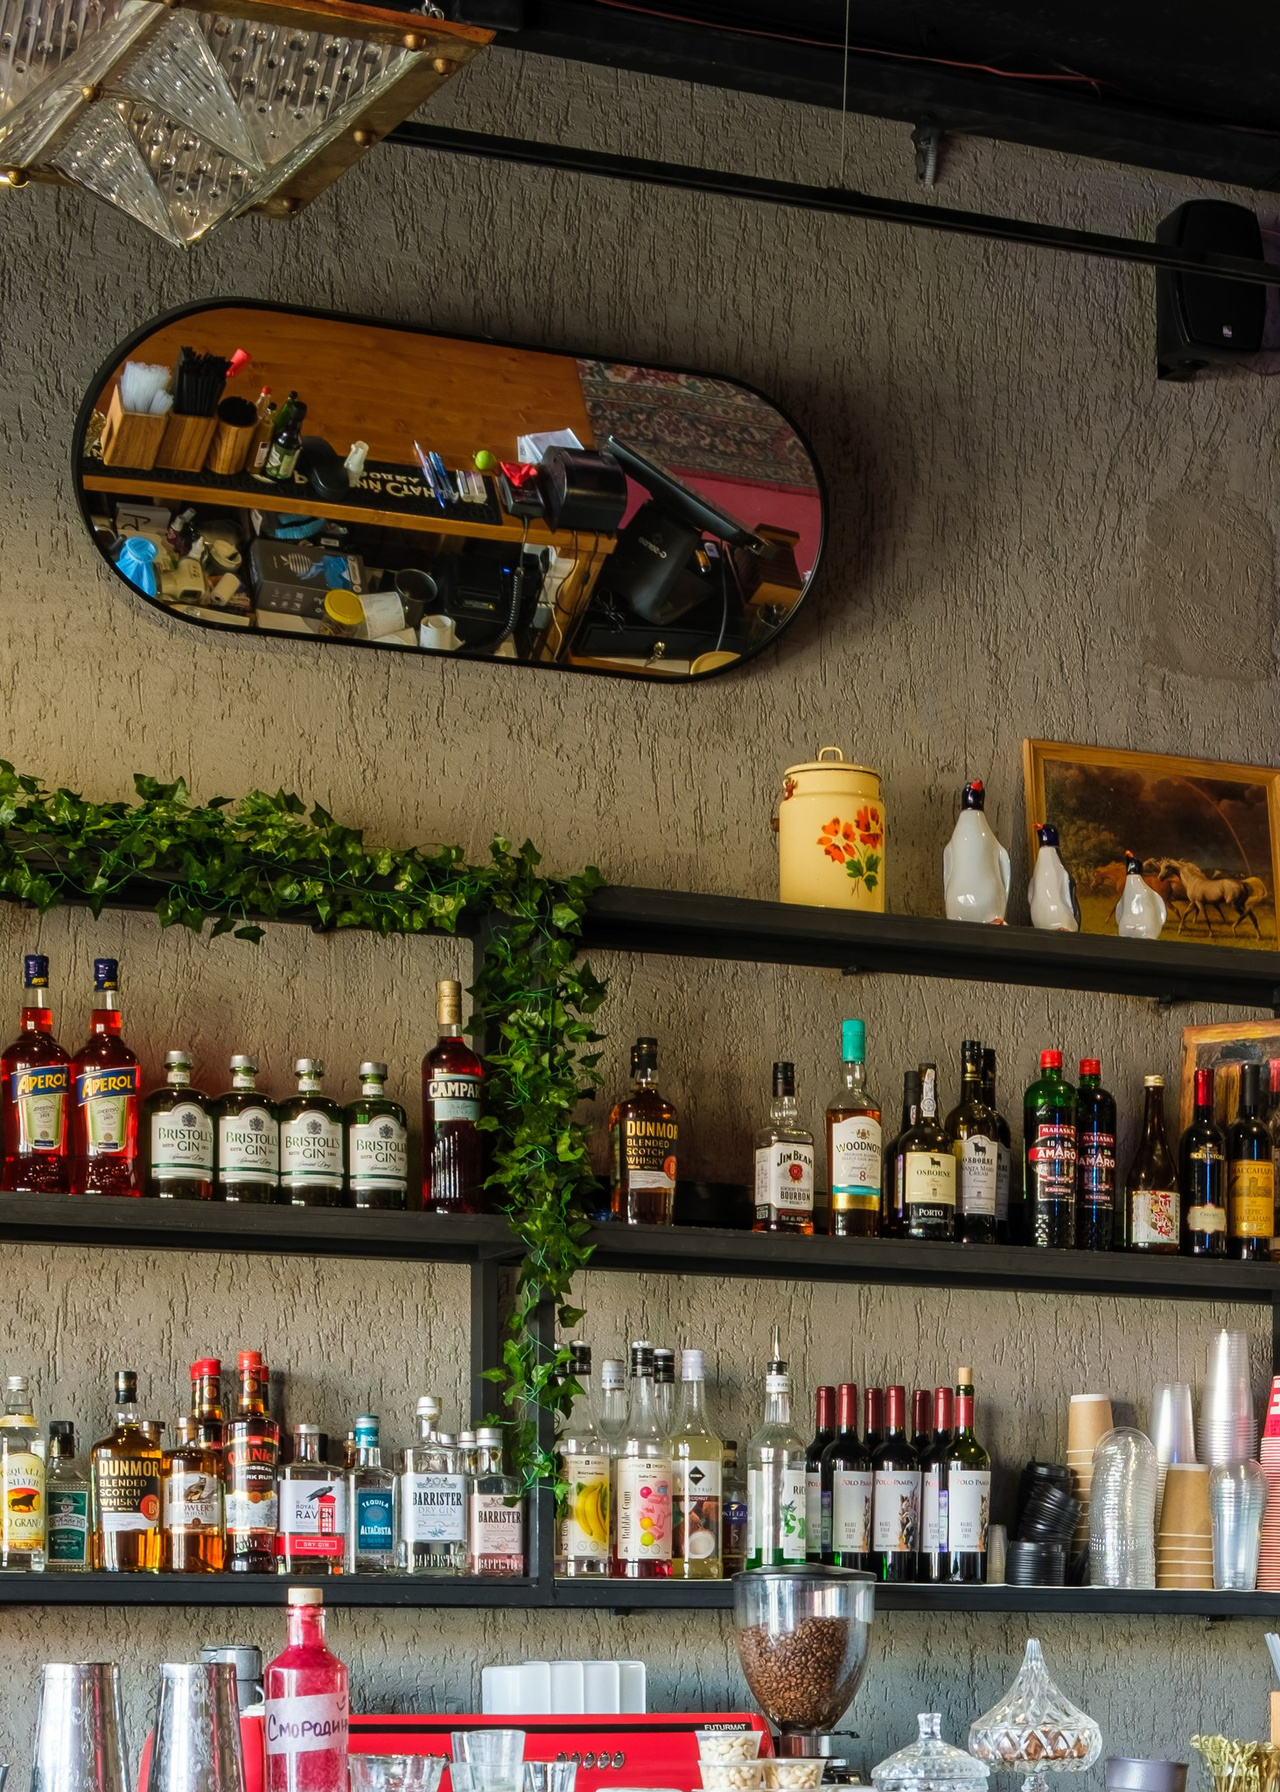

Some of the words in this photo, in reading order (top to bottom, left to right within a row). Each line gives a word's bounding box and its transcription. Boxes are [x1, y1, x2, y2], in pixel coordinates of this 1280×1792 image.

[17, 1073, 67, 1095] APEROL
[82, 1075, 133, 1099] APEROL
[1042, 1126, 1075, 1135] MARASKA
[177, 1140, 200, 1152] GIN
[626, 1138, 670, 1148] BLENDED
[245, 1145, 267, 1156] GIN
[302, 1148, 325, 1159] GIN
[626, 1147, 664, 1156] SCOTCH
[1037, 1142, 1076, 1160] AMARO
[375, 1152, 397, 1163] GIN
[626, 1156, 663, 1165] WHISKY
[777, 1152, 792, 1167] JIM
[1079, 1150, 1115, 1168] AMARO
[860, 1171, 866, 1181] 8
[916, 1169, 951, 1178] OSBORNE
[780, 1191, 810, 1201] BOURBON
[919, 1207, 944, 1217] PORTO
[8, 1479, 39, 1488] SILVER
[99, 1479, 147, 1488] BLENDED
[99, 1488, 140, 1497] SCOTCH
[99, 1498, 140, 1506] WHISKY
[412, 1491, 463, 1506] BARRISTER
[361, 1499, 389, 1509] TEQUILA
[418, 1506, 434, 1514] DRY
[438, 1506, 456, 1514] GIN
[478, 1510, 522, 1524] BARRISTER
